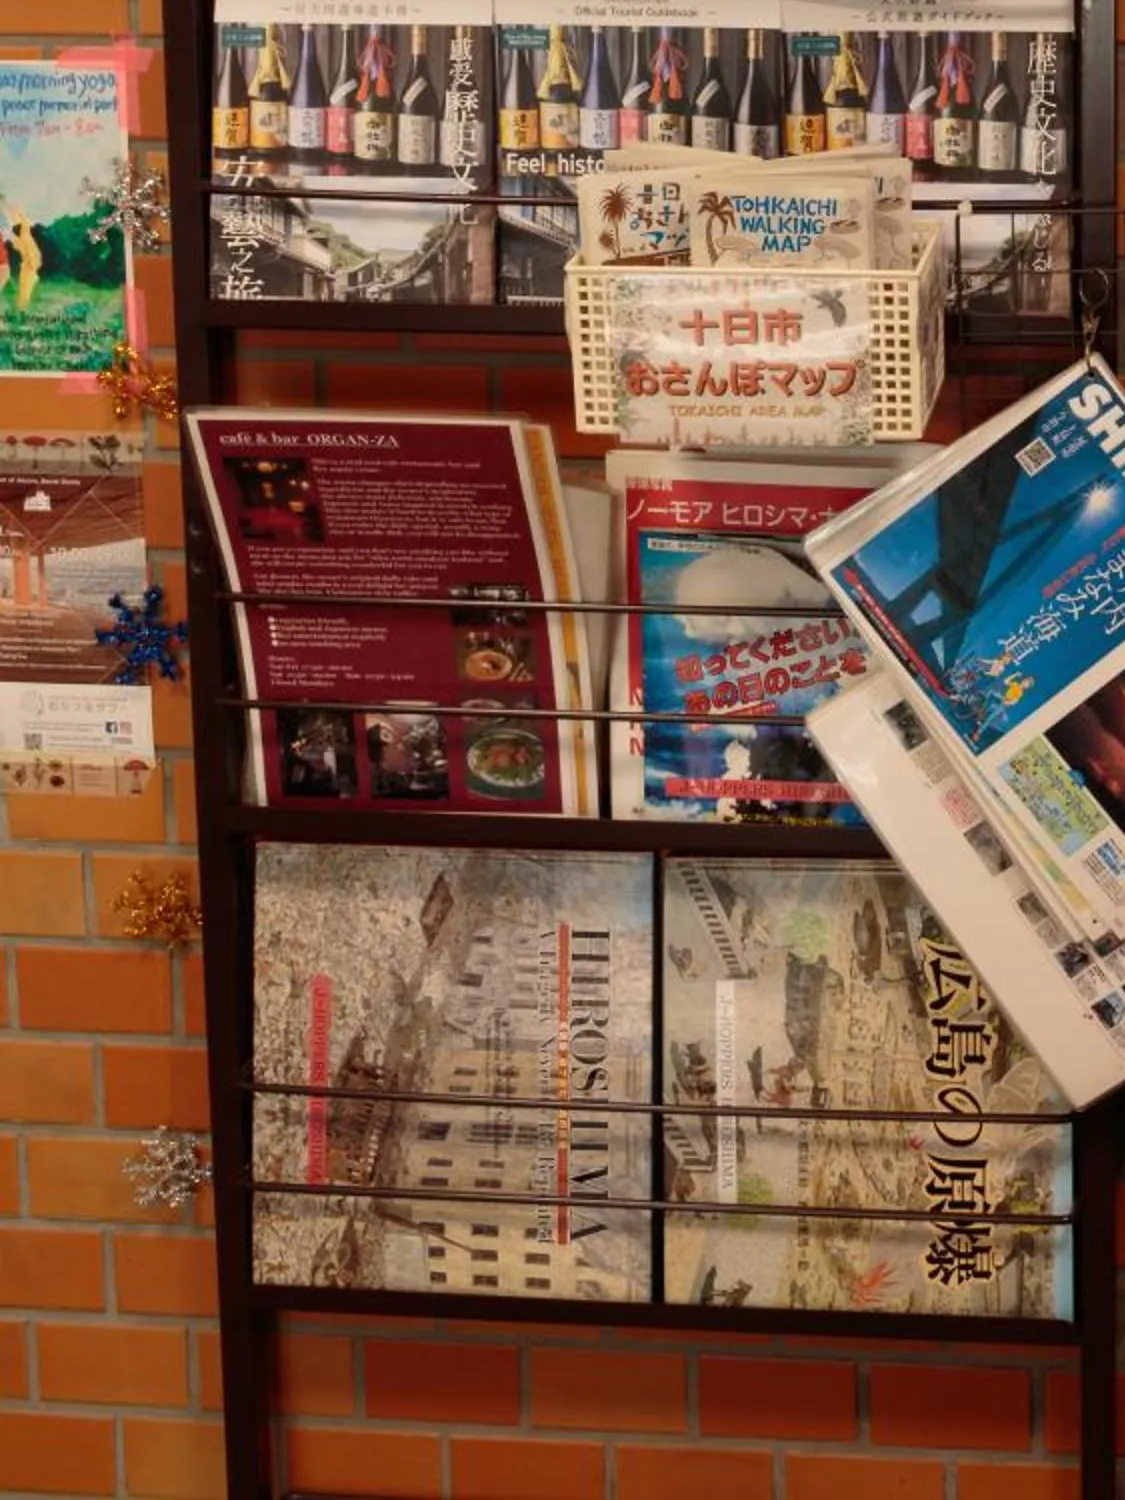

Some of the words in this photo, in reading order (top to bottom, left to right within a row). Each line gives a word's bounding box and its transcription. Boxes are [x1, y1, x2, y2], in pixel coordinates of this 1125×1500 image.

[506, 153, 545, 174] Feel
[732, 195, 838, 217] TOHKAICHI
[740, 216, 826, 235] WALKING
[761, 234, 812, 253] MAP
[679, 307, 803, 347] 十日市
[624, 358, 866, 397] おさんぽマップ
[627, 500, 713, 524] ノーモア
